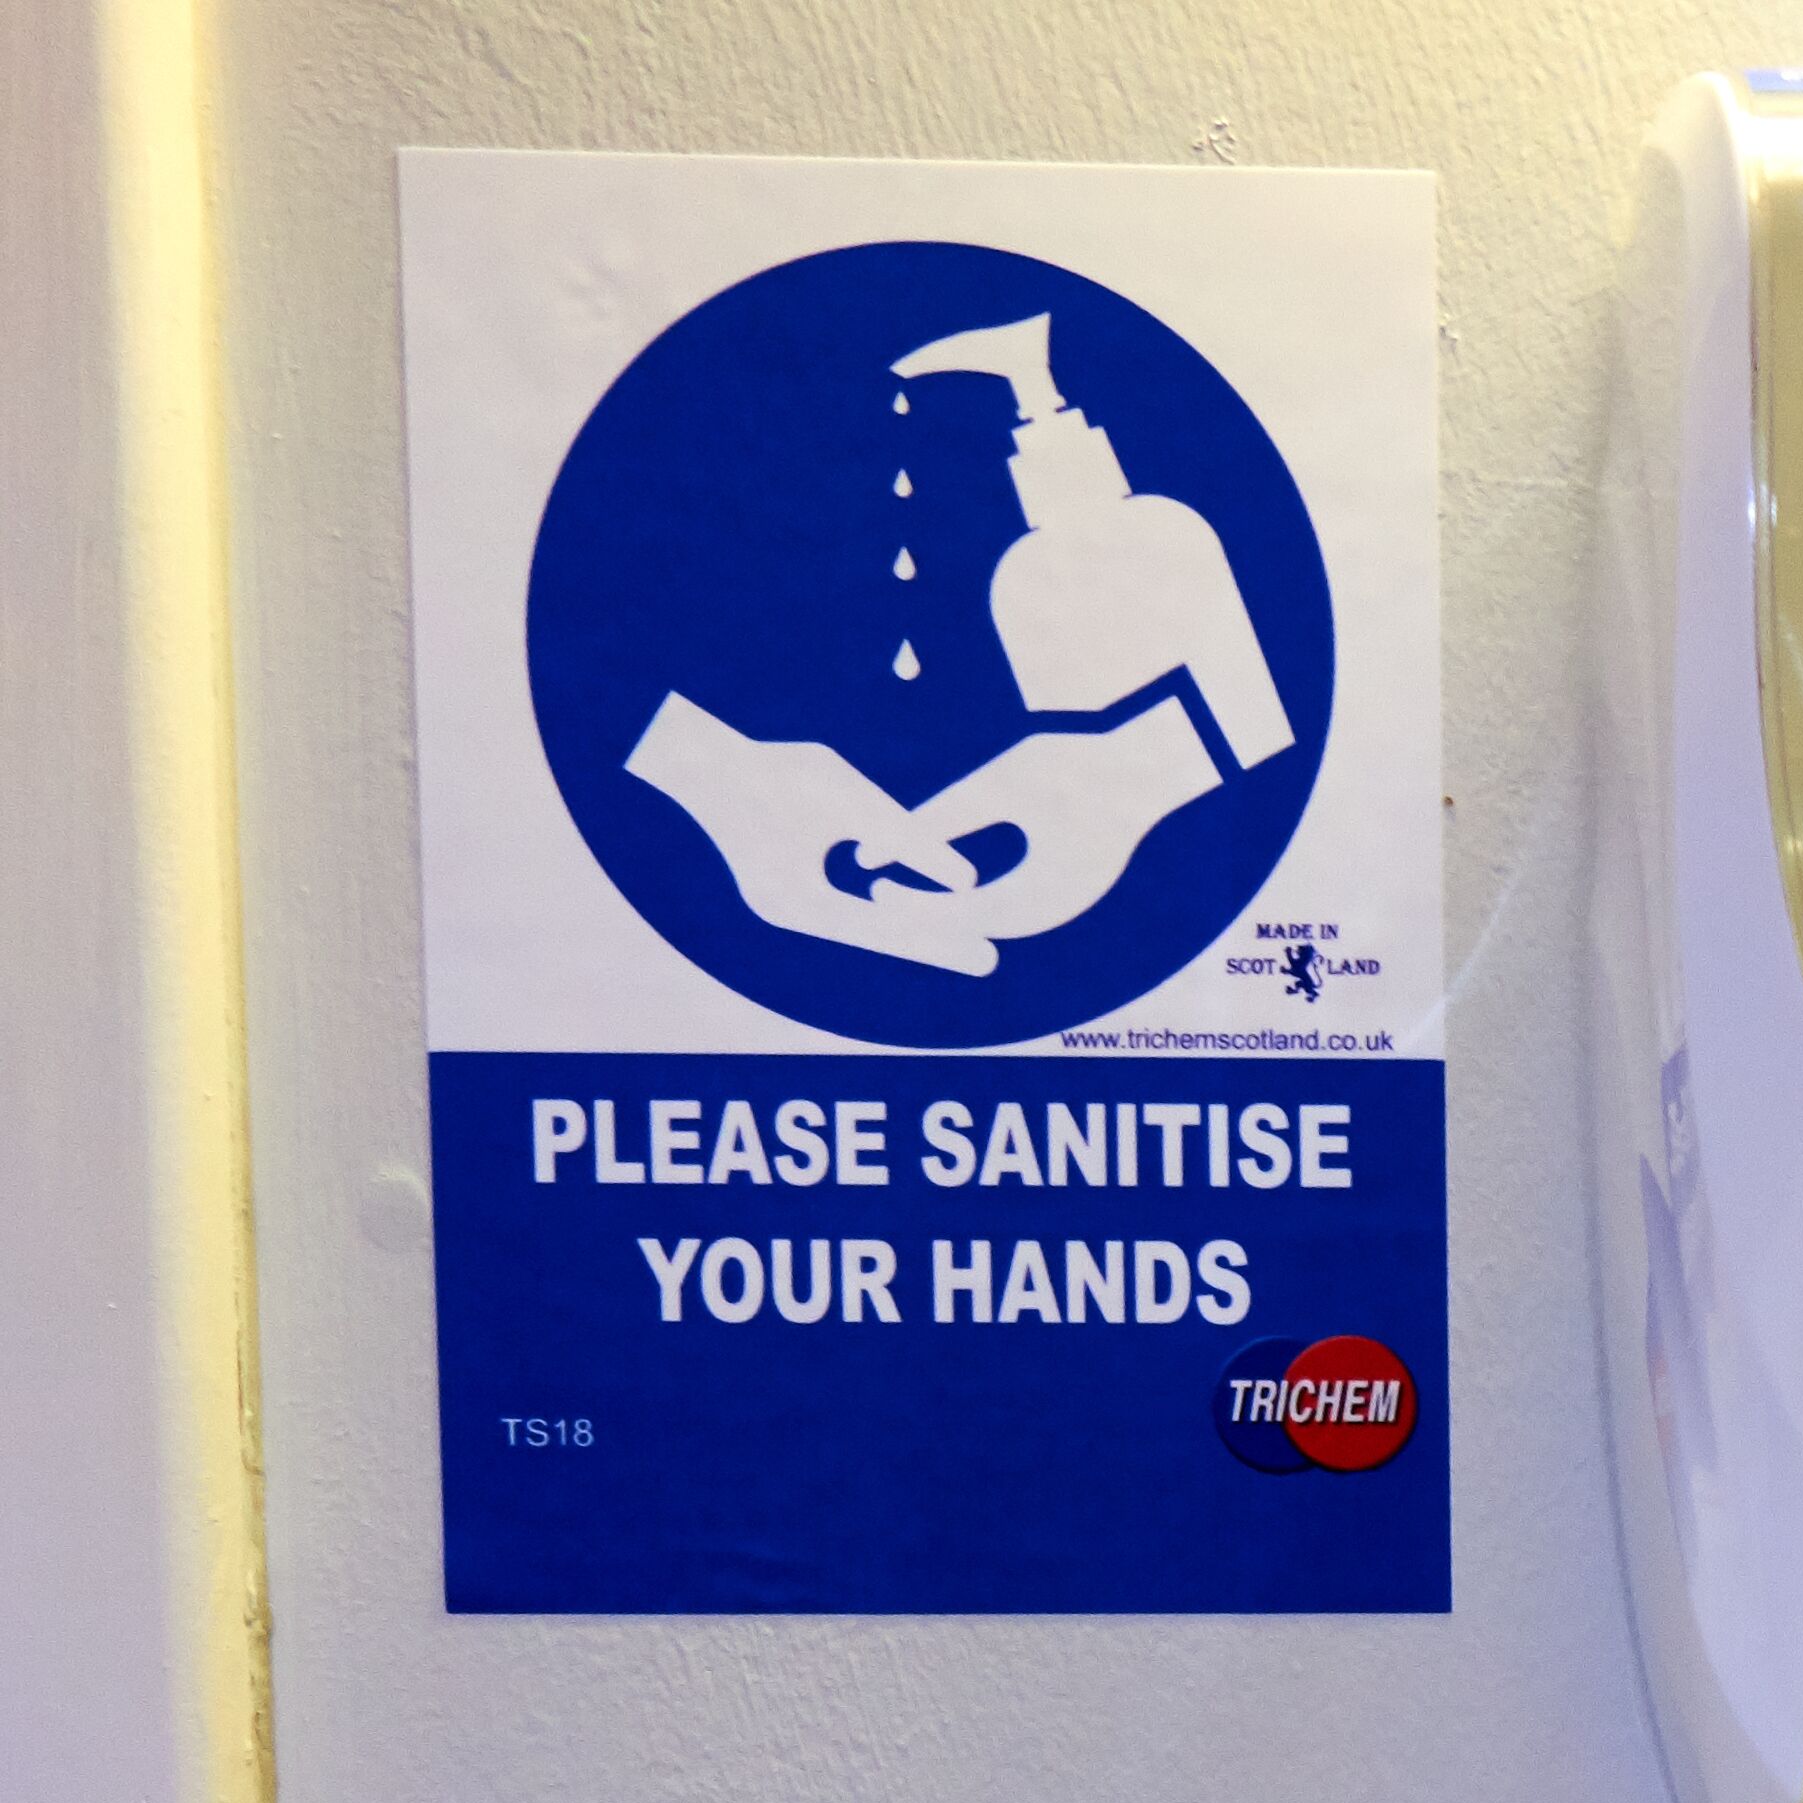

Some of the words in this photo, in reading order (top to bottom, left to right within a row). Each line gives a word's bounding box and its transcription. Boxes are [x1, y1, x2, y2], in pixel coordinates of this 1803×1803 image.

[1256, 923, 1313, 939] MADE
[1320, 923, 1340, 940] IN
[1060, 1027, 1394, 1051] www.trichemscotland.co.uk
[532, 1099, 890, 1188] PLEASE
[921, 1100, 1353, 1190] SANITISE
[639, 1237, 902, 1324] YOUR
[931, 1238, 1253, 1327] HANDS
[1226, 1376, 1401, 1425] TRICHEM
[501, 1416, 594, 1448] TS18
